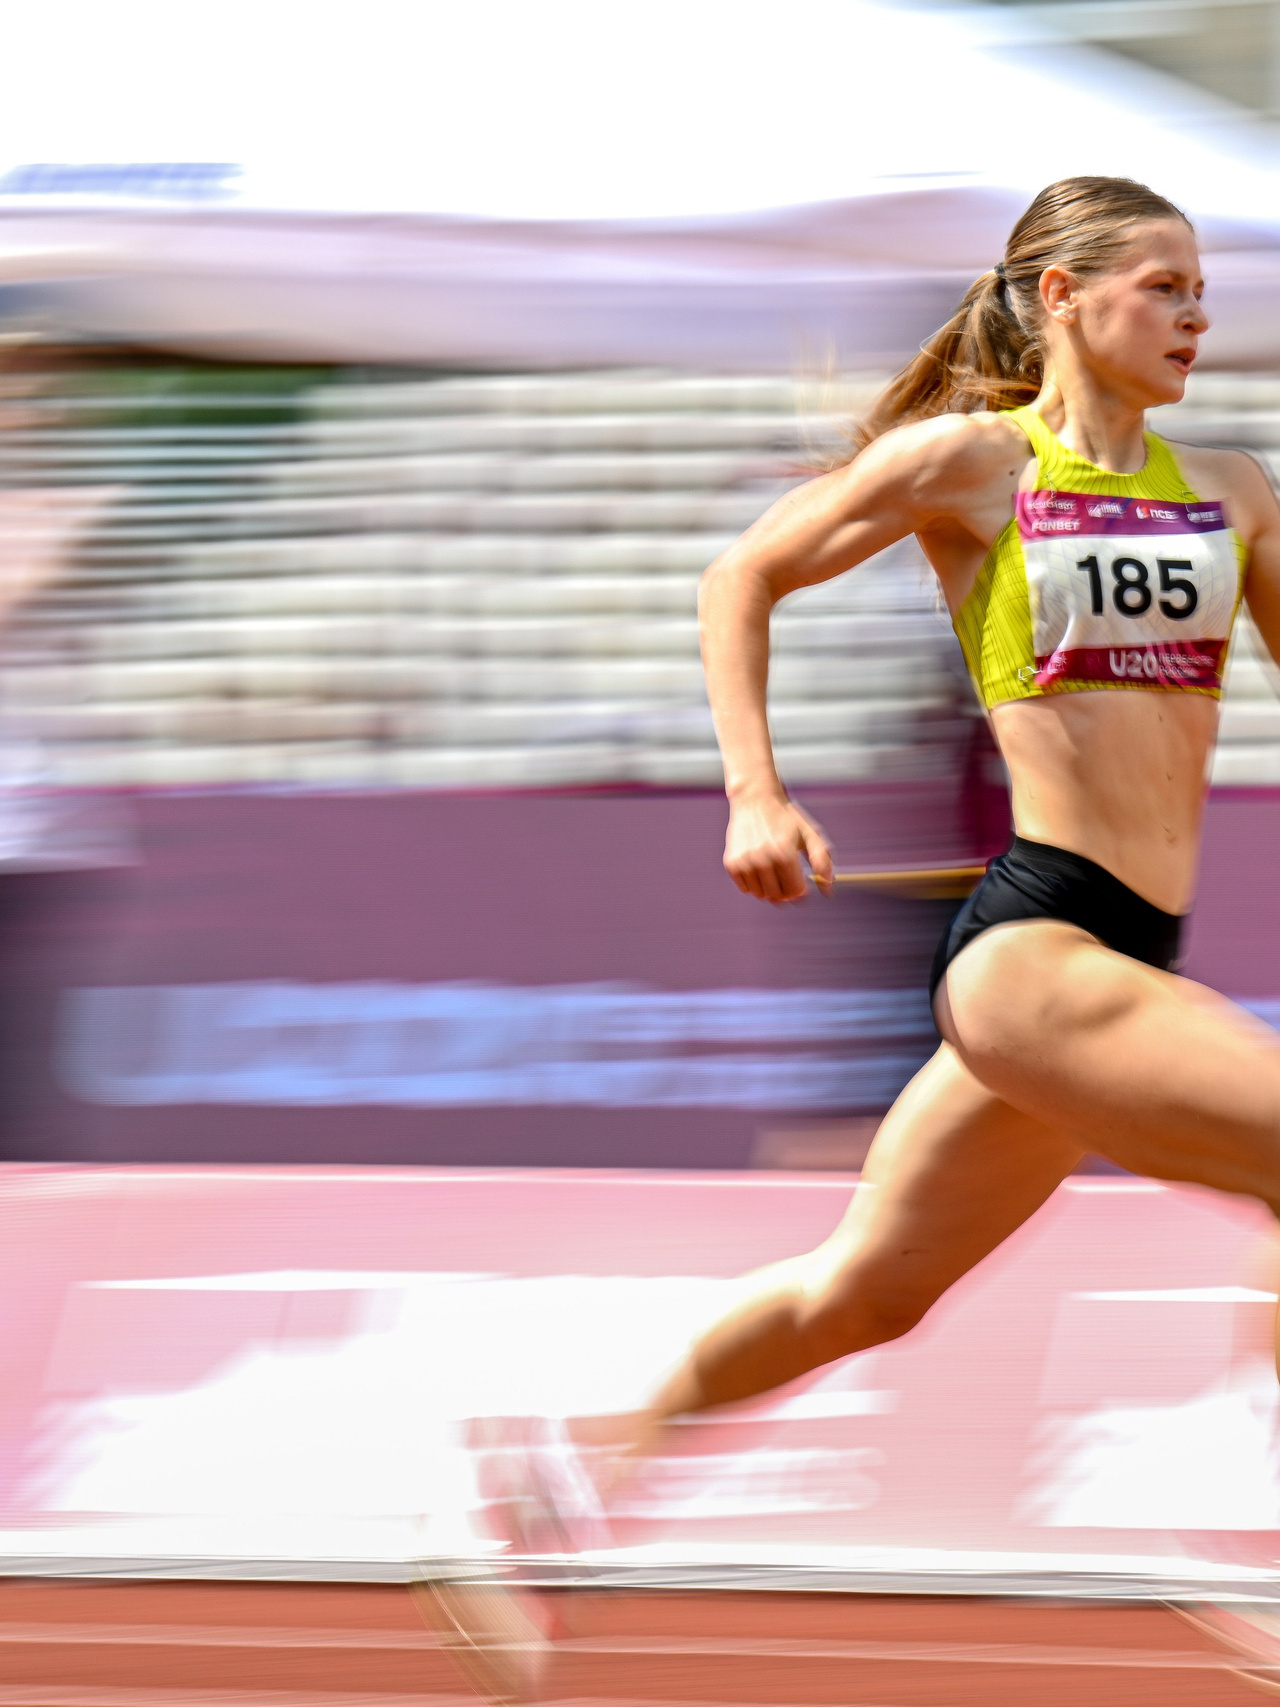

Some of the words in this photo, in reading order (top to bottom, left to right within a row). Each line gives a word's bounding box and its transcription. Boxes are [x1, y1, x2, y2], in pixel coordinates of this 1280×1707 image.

[1031, 517, 1081, 532] FONBET
[1076, 555, 1198, 620] 185
[1109, 649, 1158, 678] U20
